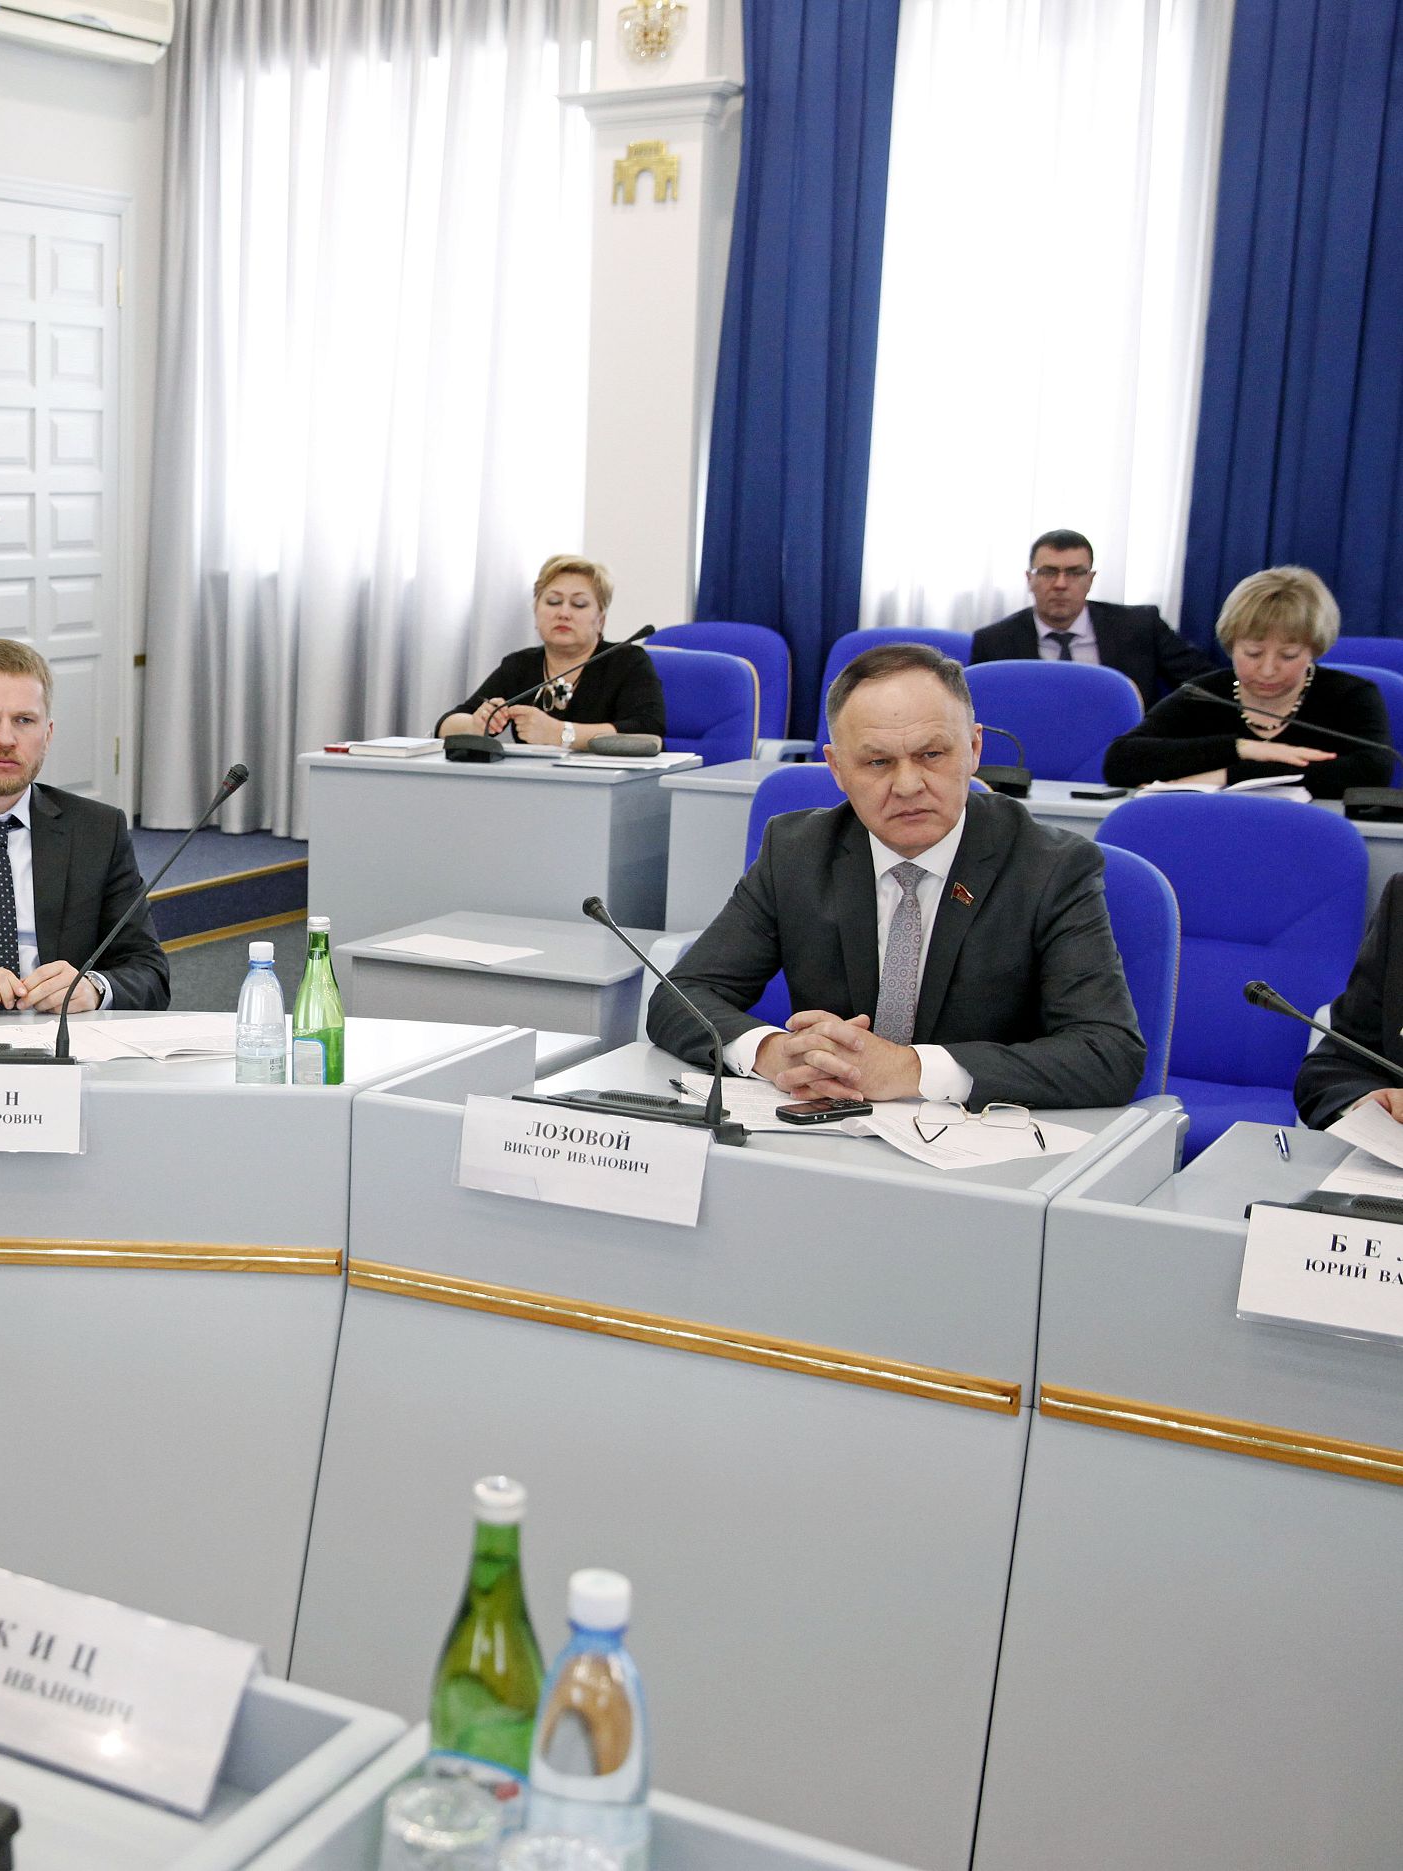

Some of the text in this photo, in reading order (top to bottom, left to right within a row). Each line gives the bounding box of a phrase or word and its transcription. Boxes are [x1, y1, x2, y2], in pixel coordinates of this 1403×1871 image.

[526, 1121, 631, 1151] ЛОЗОВОЙ
[503, 1140, 649, 1174] ВИКТОР ИВАНОВИЧ
[1329, 1233, 1403, 1262] БЕ
[1305, 1258, 1367, 1280] ЮРИЙ
[1, 1666, 134, 1722] ИВАНОВИЧ
